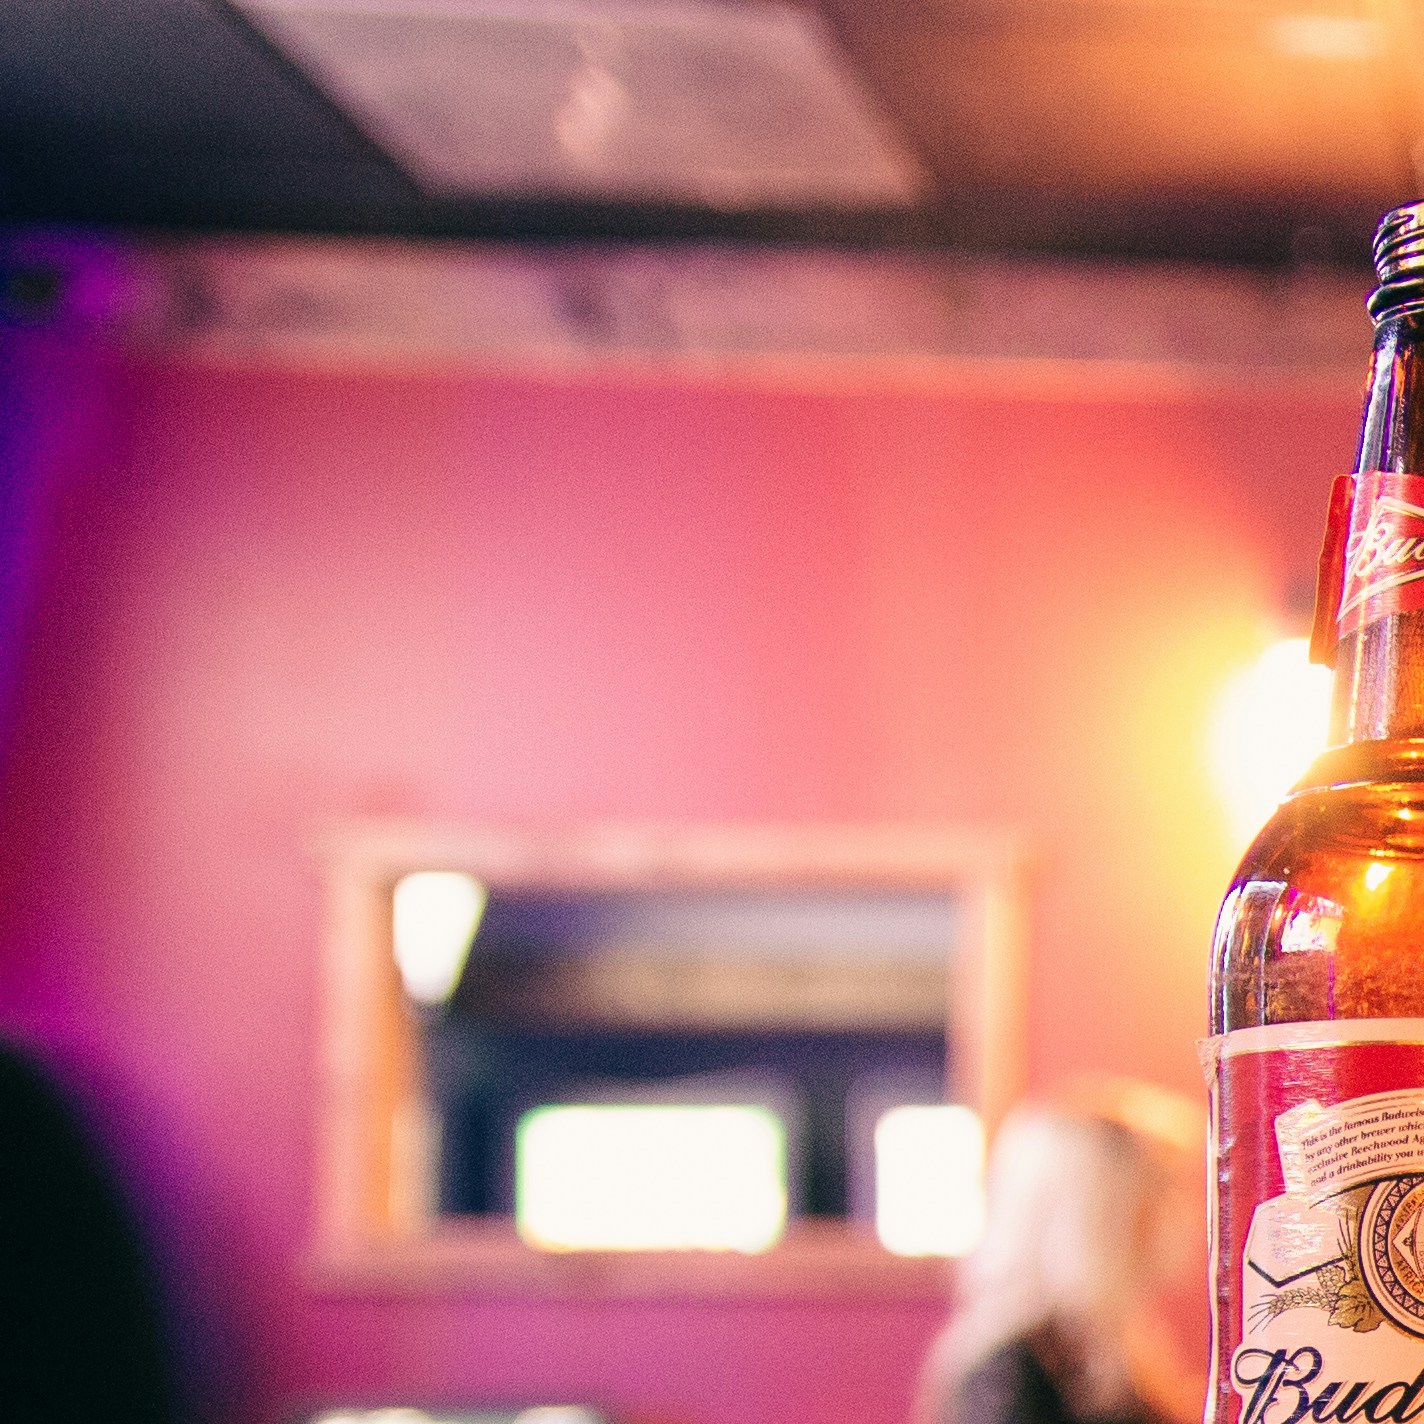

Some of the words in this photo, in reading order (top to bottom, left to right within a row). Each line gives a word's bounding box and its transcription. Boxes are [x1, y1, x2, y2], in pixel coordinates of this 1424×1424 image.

[1329, 1126, 1342, 1138] the
[1344, 1116, 1380, 1131] famous
[1316, 1143, 1333, 1157] any
[1334, 1135, 1358, 1150] other
[1360, 1125, 1396, 1141] brewer
[1351, 1134, 1409, 1155] Beechwood
[1328, 1170, 1335, 1179] a
[1336, 1152, 1393, 1176] drinkability
[1395, 1150, 1414, 1162] you
